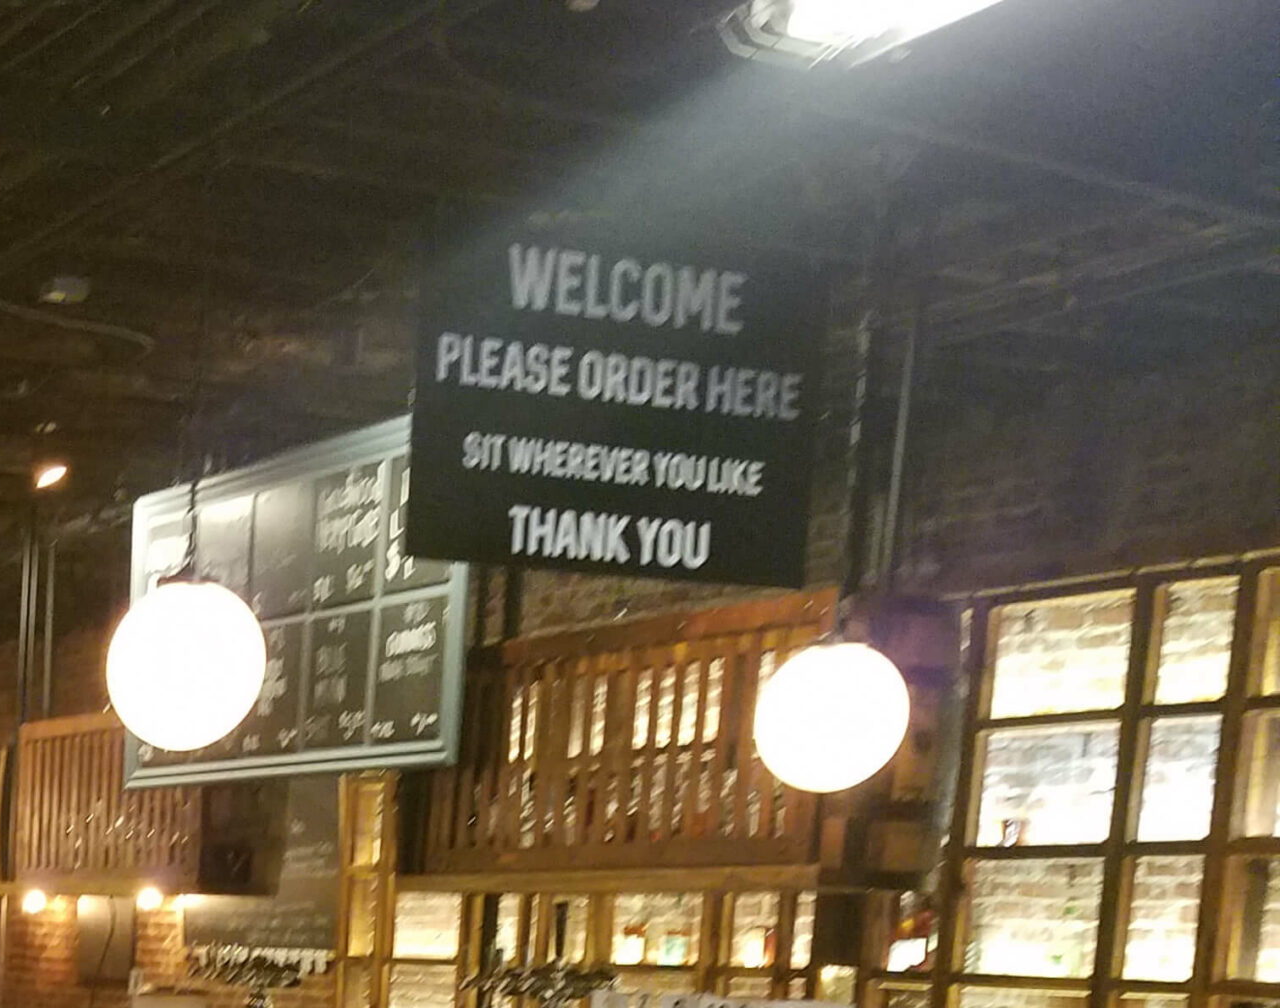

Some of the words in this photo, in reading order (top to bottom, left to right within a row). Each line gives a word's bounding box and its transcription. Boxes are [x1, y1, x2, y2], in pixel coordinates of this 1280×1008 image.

[509, 242, 749, 335] WELCOME
[435, 331, 574, 396] PLEASE
[577, 349, 699, 411] ORDER
[706, 363, 805, 421] HERE
[462, 431, 506, 471] SIT
[507, 435, 651, 486] WHEREVER
[653, 450, 706, 492] YOU
[707, 456, 766, 496] LIKE
[508, 505, 631, 563] THANK
[636, 517, 711, 569] YOU
